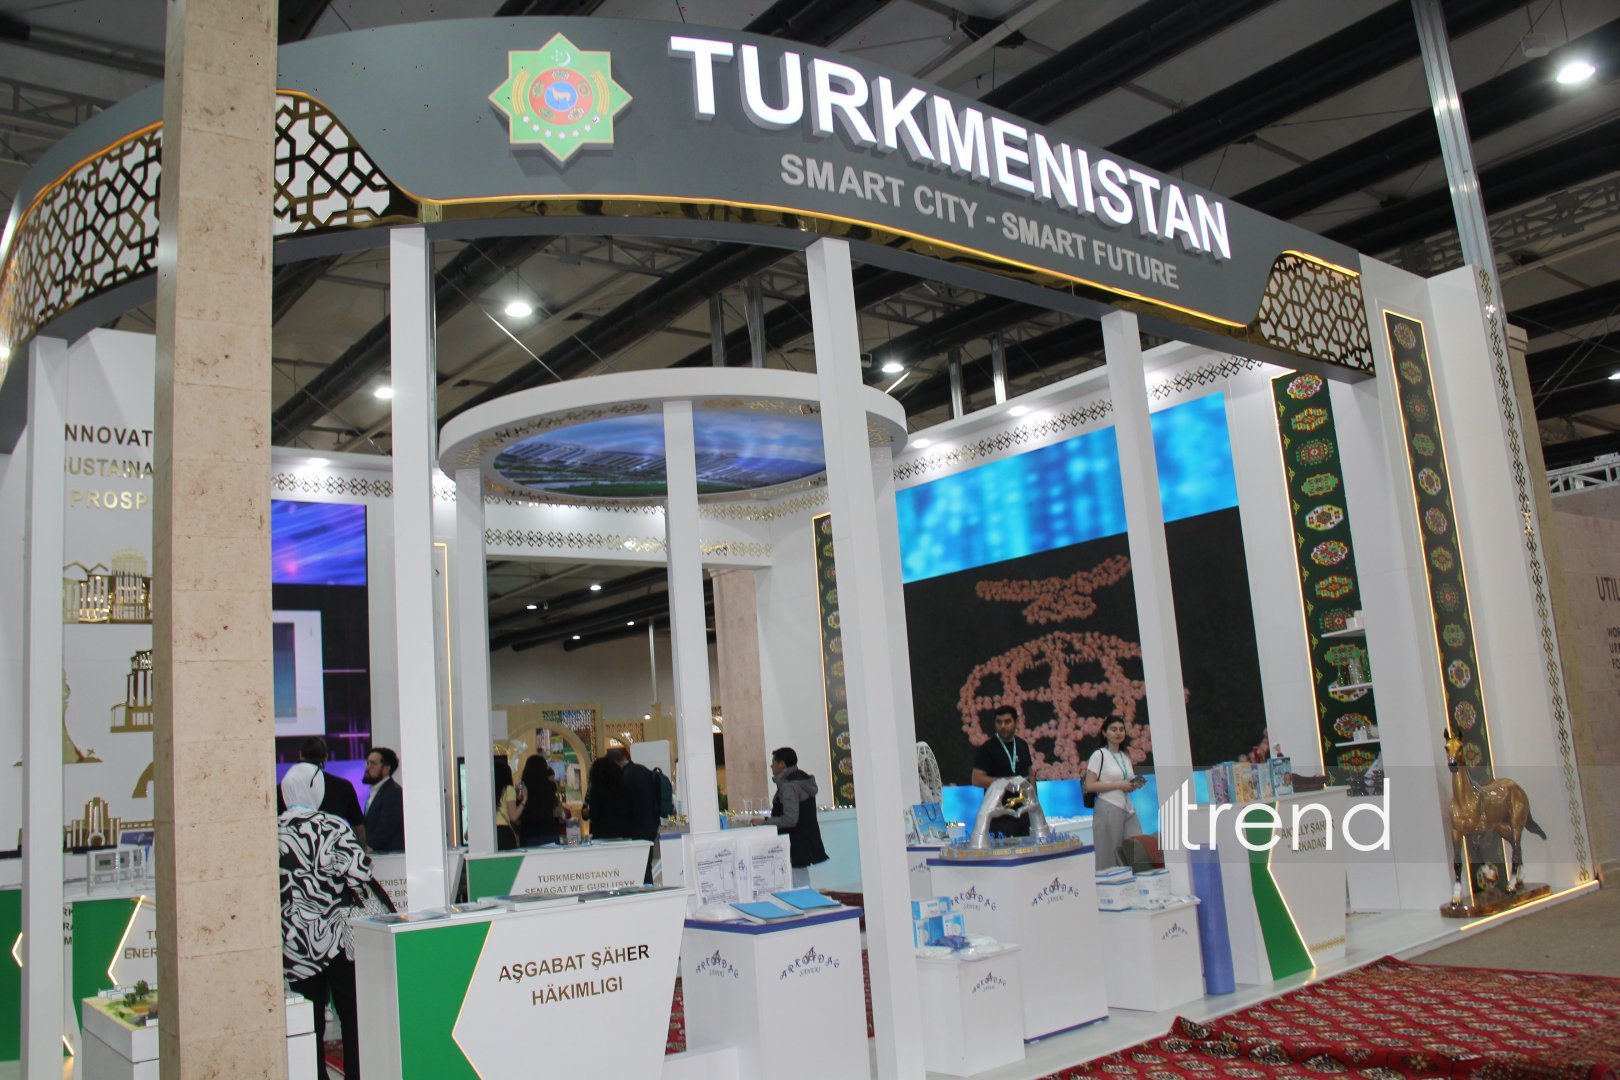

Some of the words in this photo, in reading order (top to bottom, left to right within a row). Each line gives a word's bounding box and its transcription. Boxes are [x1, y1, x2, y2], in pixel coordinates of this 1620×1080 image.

[667, 35, 1232, 261] TURKMENISTAN
[780, 153, 904, 208] SMART
[914, 184, 978, 229] CITY
[1002, 211, 1086, 262] SMART
[1093, 240, 1180, 290] FUTURE
[65, 423, 153, 447] NNOVAT
[70, 489, 150, 510] PROSP
[1595, 576, 1620, 602] UTIL
[570, 884, 585, 892] WE
[124, 948, 158, 960] ENER
[498, 953, 586, 984] AŞGABAT
[591, 944, 650, 970] ŞÄHER
[532, 976, 623, 1006] HÄKIMLIGI
